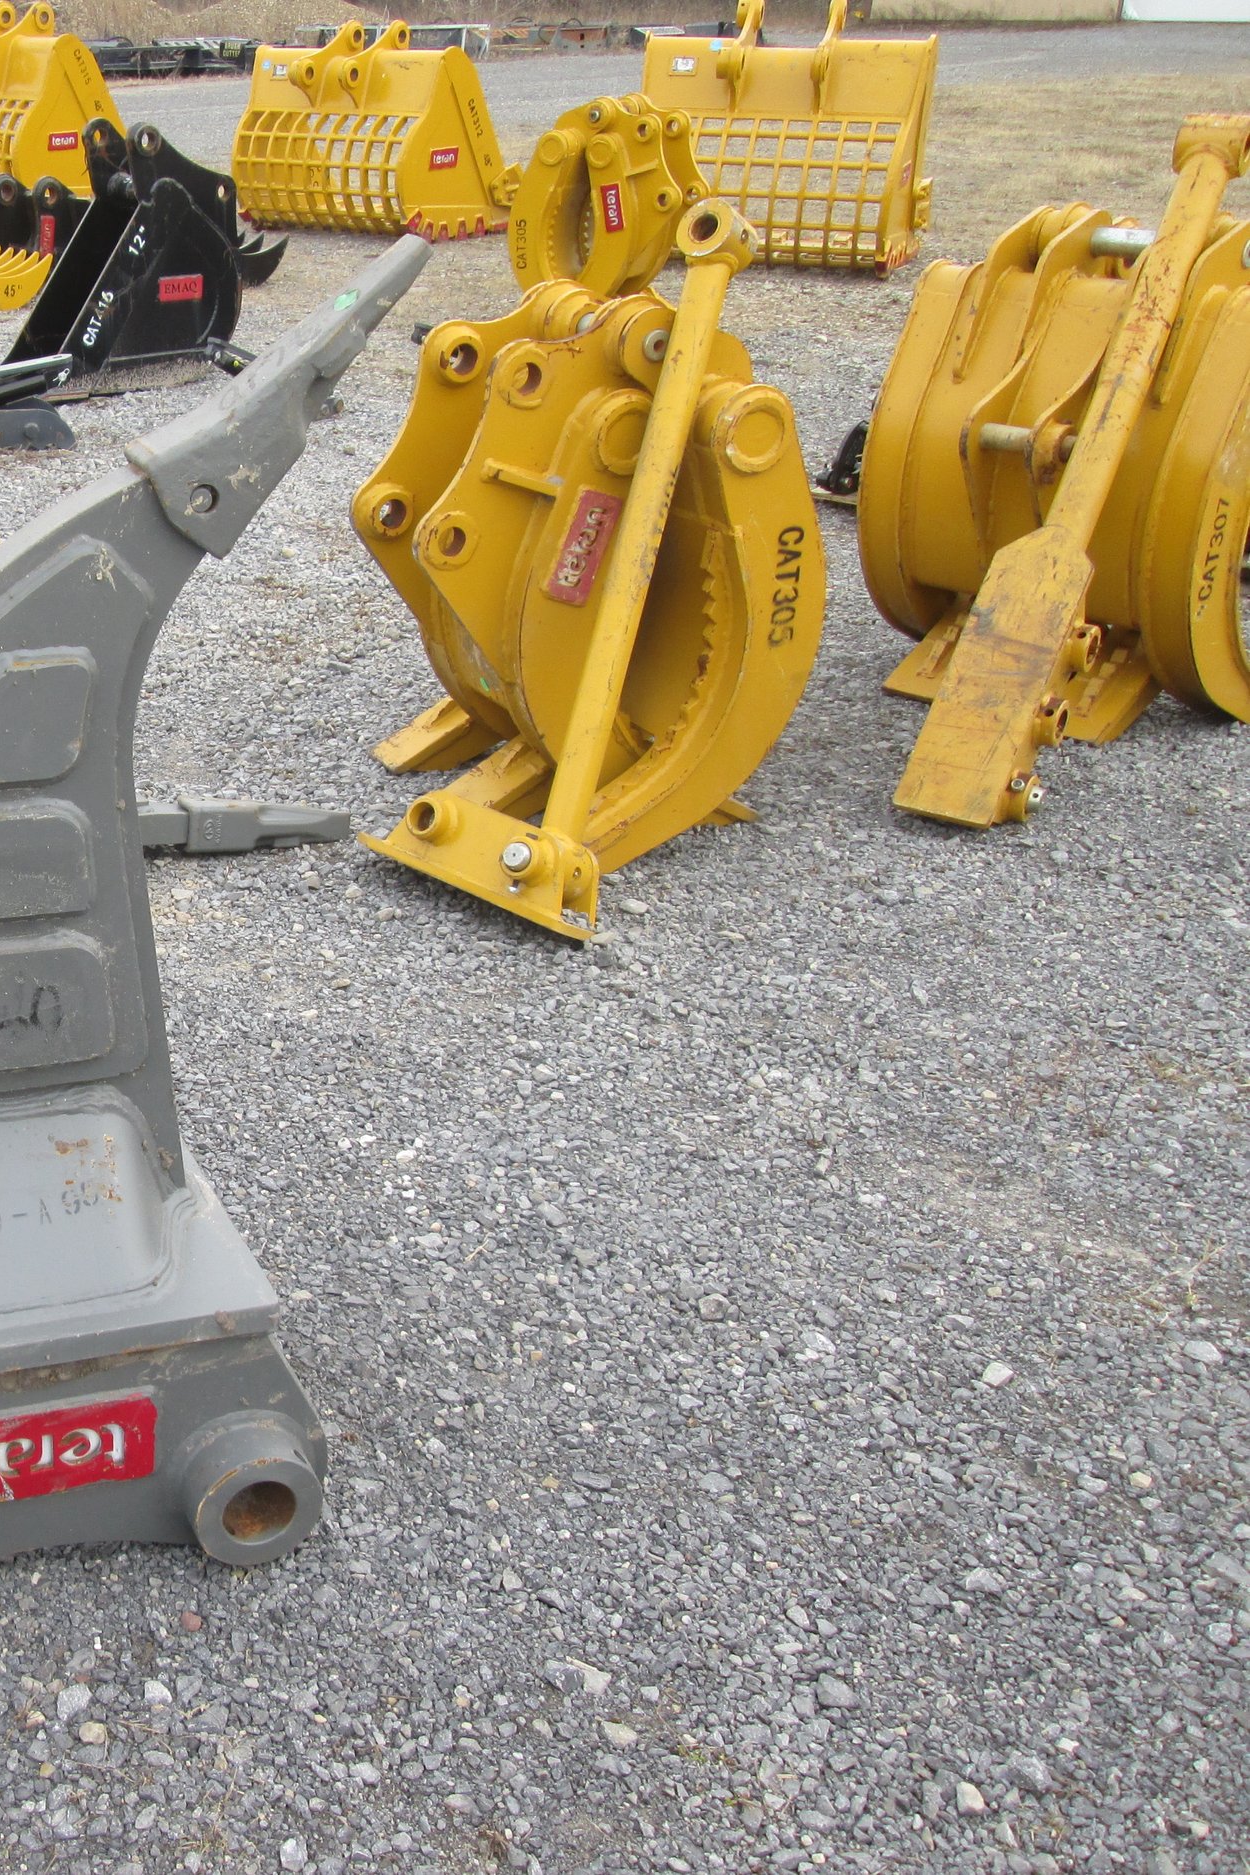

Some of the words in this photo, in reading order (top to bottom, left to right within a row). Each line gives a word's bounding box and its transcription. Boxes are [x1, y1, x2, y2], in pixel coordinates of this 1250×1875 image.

[74, 49, 91, 85] CAT315
[468, 98, 483, 138] CAT312
[52, 136, 75, 146] teran
[433, 153, 455, 164] teran
[606, 189, 619, 226] teran
[128, 225, 146, 255] 12"
[516, 219, 527, 270] CAT305
[4, 284, 23, 297] 45"
[164, 281, 199, 294] EMAQ
[557, 507, 607, 588] teran
[766, 526, 805, 648] CAT305
